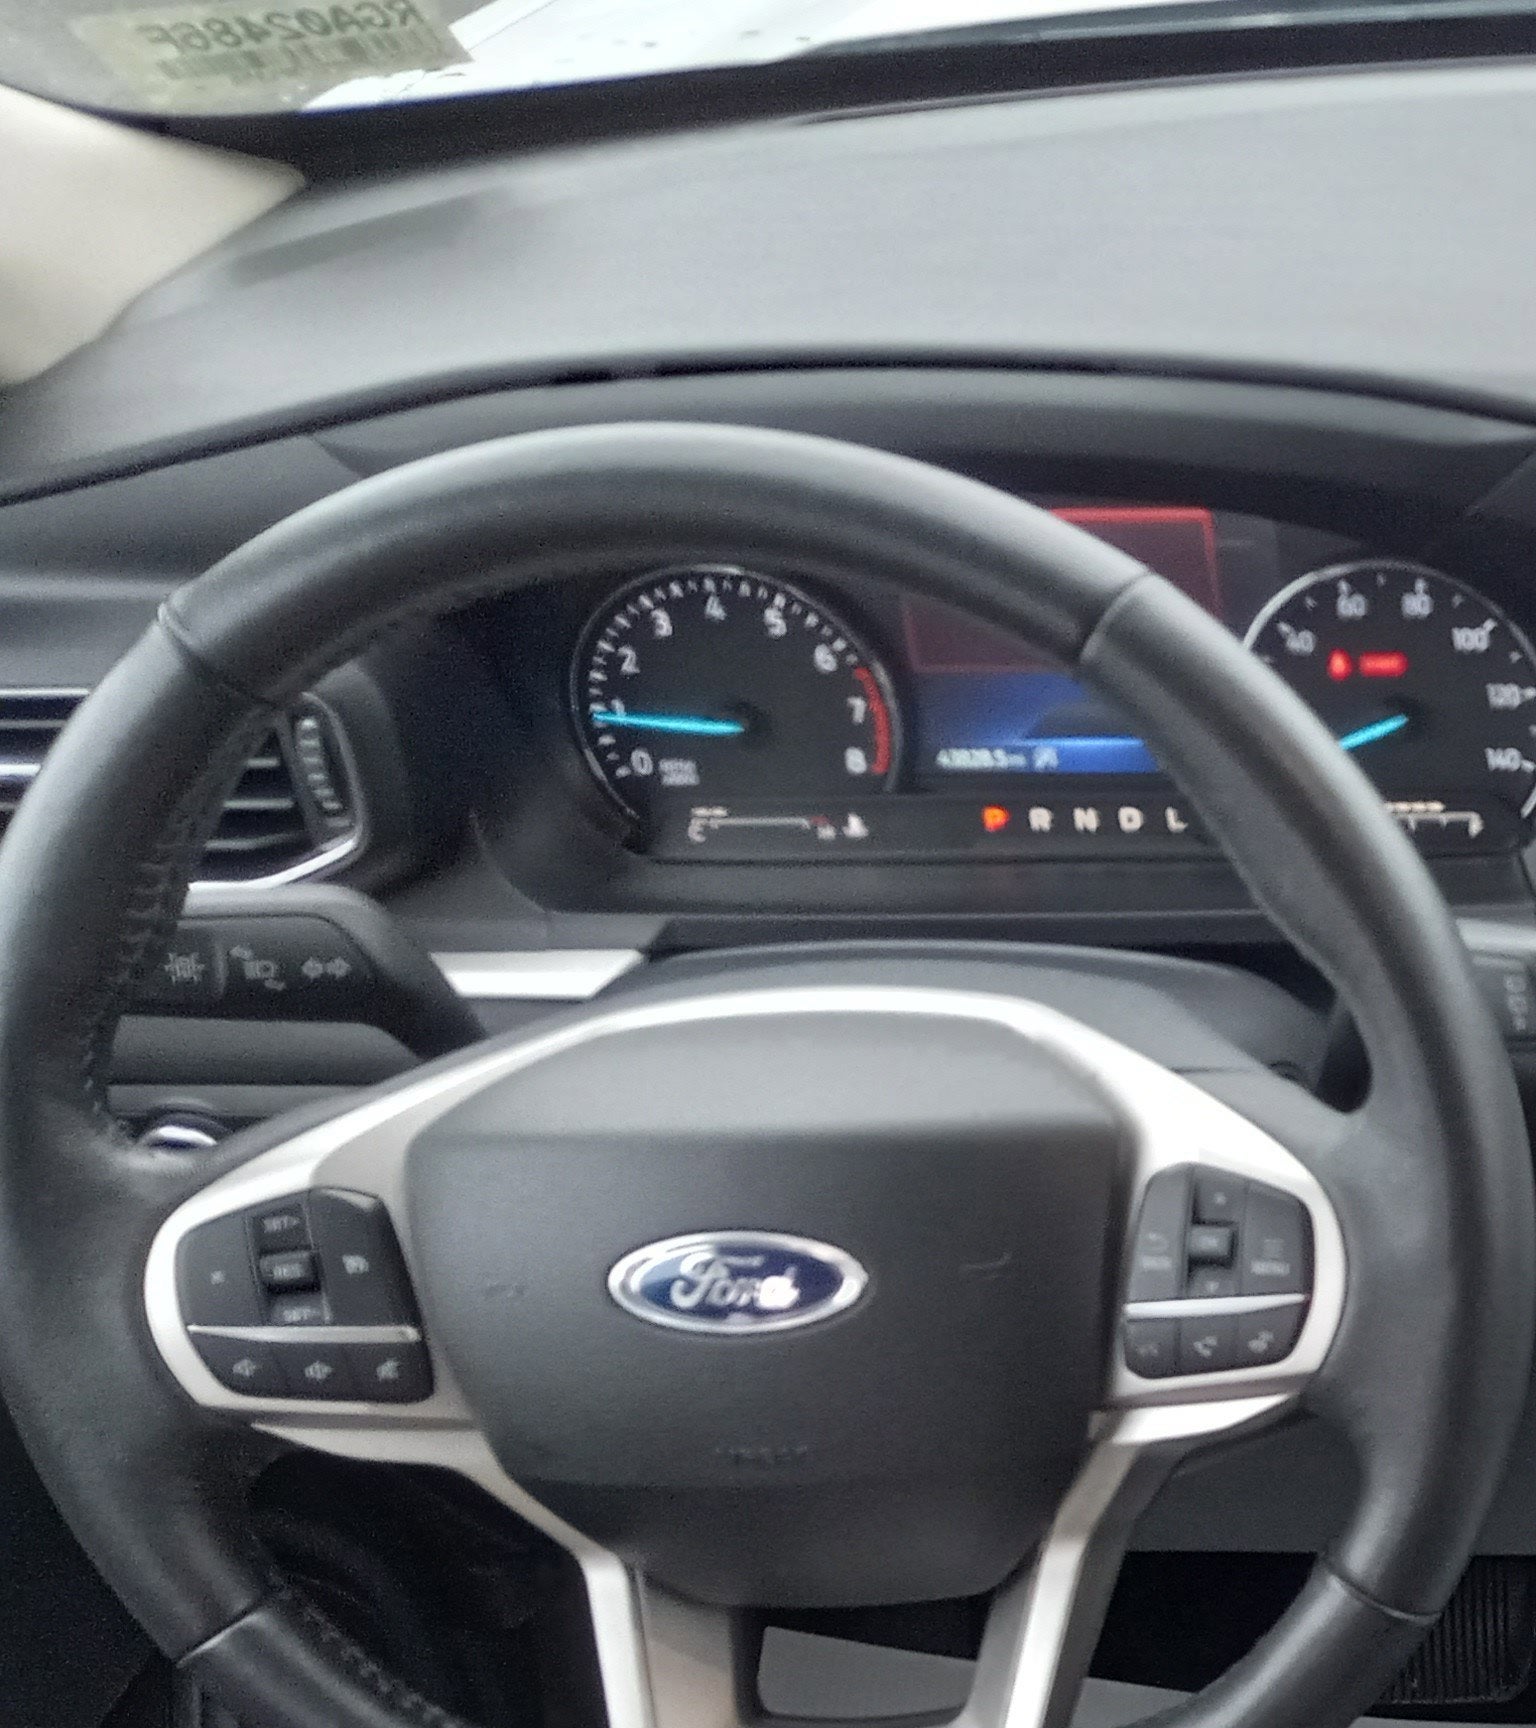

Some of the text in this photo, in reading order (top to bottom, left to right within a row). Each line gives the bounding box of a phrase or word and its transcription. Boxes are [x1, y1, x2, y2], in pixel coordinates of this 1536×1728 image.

[705, 595, 727, 621] 4
[1336, 594, 1368, 618] 60
[650, 607, 673, 638] 3
[763, 607, 787, 638] 5
[1452, 627, 1490, 652] 100
[618, 645, 640, 674] 2
[814, 643, 837, 673] 6
[847, 696, 866, 724] 7
[1486, 683, 1521, 709] 120
[631, 747, 653, 776] 0
[1485, 747, 1522, 771] 140
[1029, 807, 1052, 832] R
[1073, 807, 1098, 832] N
[1118, 806, 1143, 832] D
[1165, 806, 1188, 832] L
[670, 1252, 800, 1310] Ford
